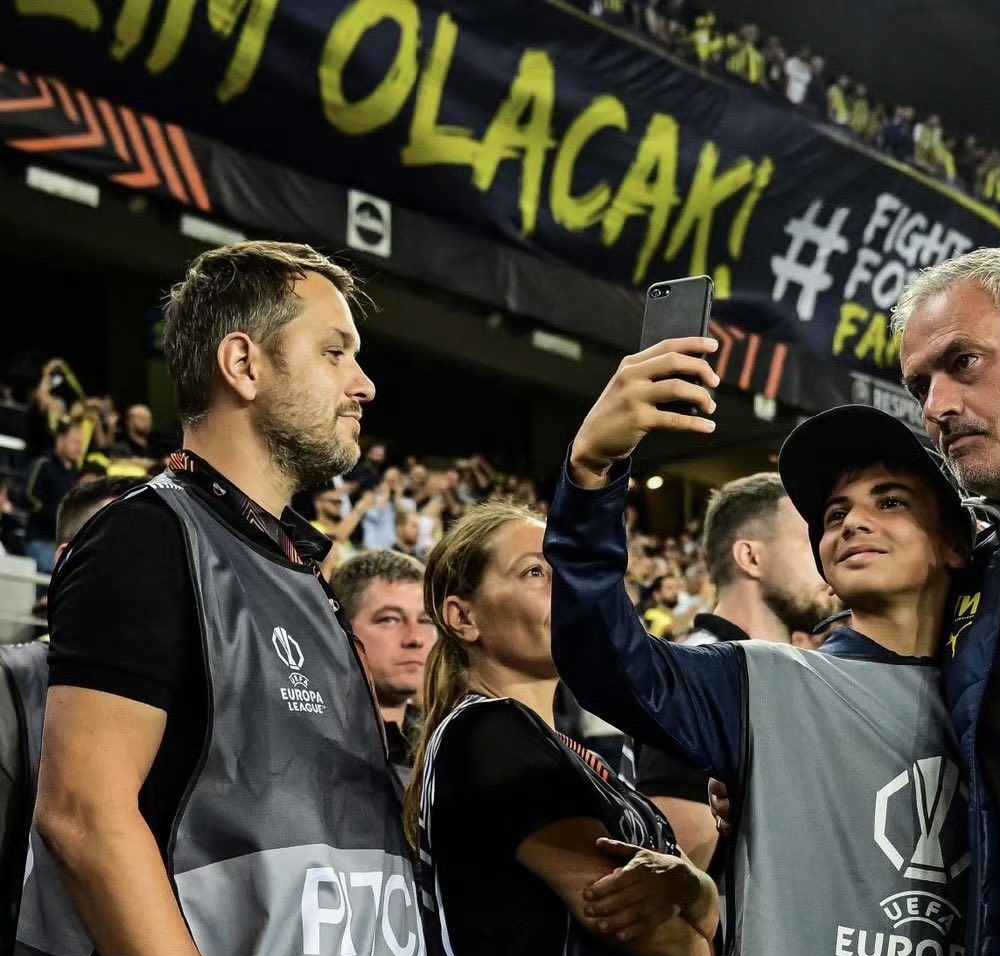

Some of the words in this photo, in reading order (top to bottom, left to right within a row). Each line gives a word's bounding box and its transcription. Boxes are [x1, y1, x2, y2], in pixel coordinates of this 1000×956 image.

[317, 0, 774, 299] OLACAK!
[863, 192, 974, 270] FIGHT
[844, 247, 919, 311] FO
[280, 687, 324, 704] EUROPA
[288, 701, 324, 714] LEAGUE
[883, 897, 955, 932] UEFA
